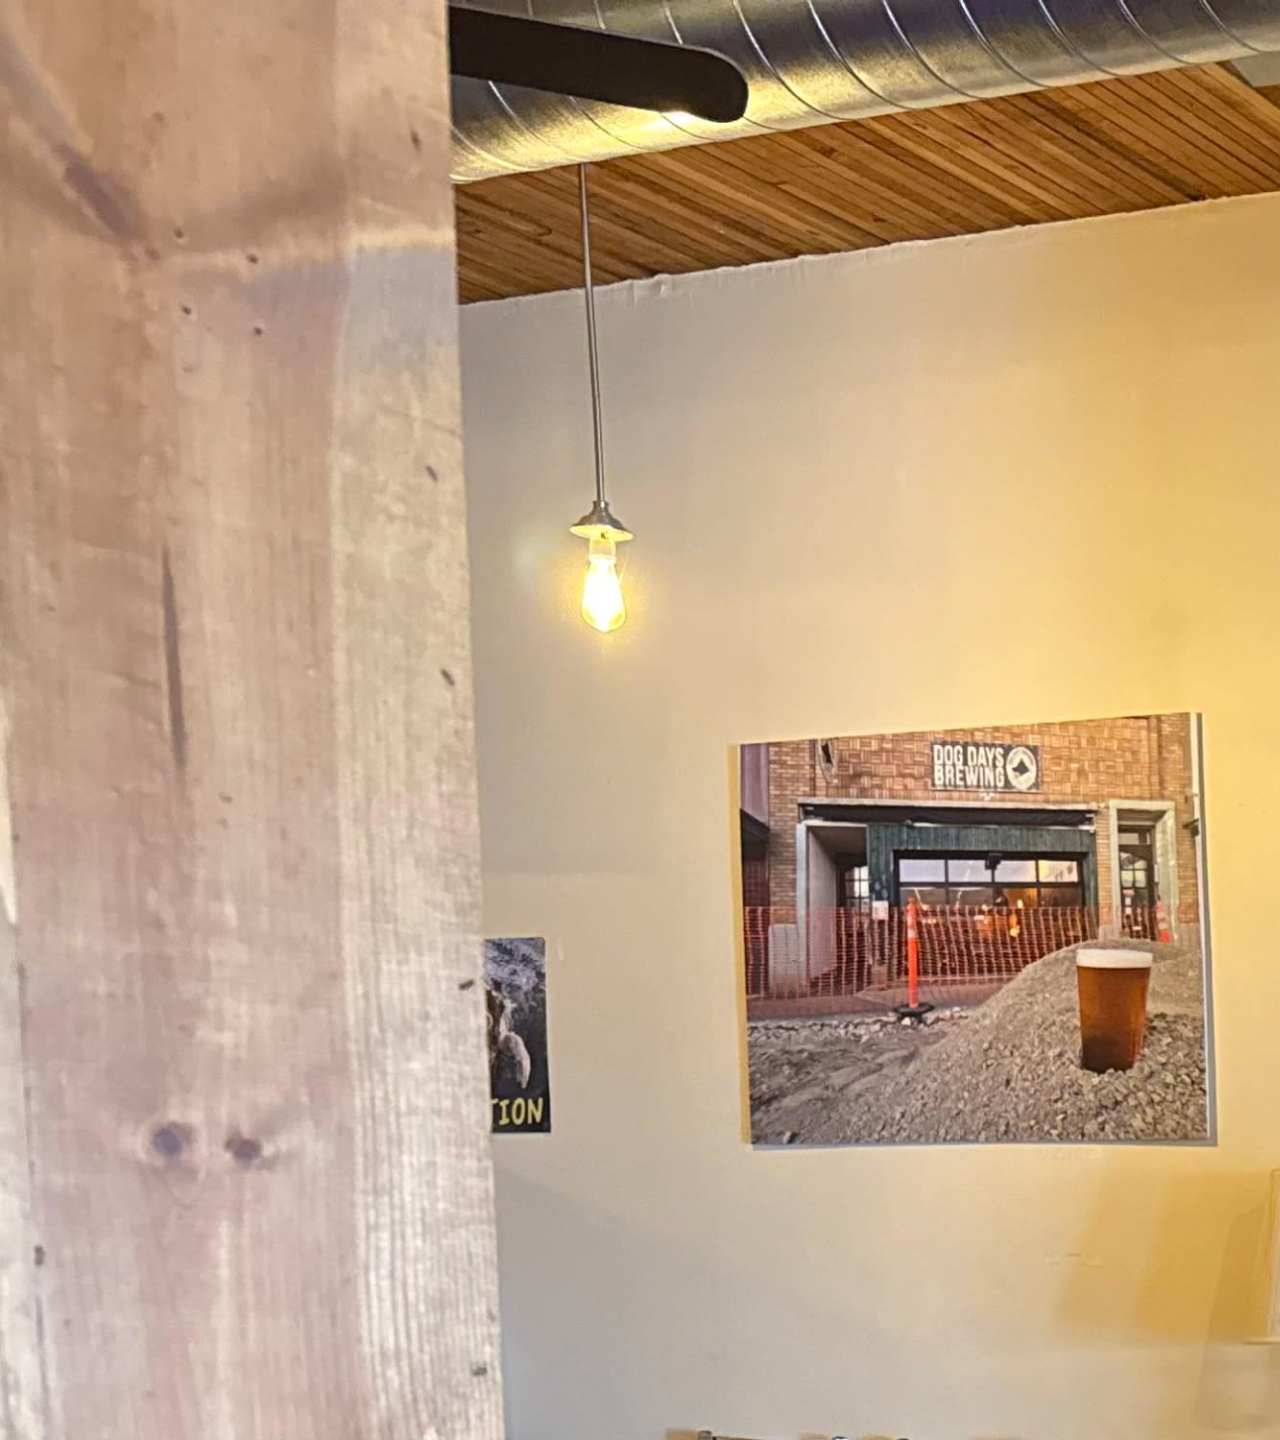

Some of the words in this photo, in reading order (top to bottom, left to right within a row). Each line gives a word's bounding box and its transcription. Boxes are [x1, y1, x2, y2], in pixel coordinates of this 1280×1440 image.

[933, 744, 963, 766] DOG
[967, 746, 1004, 768] DAYS
[934, 765, 1005, 788] BREWING
